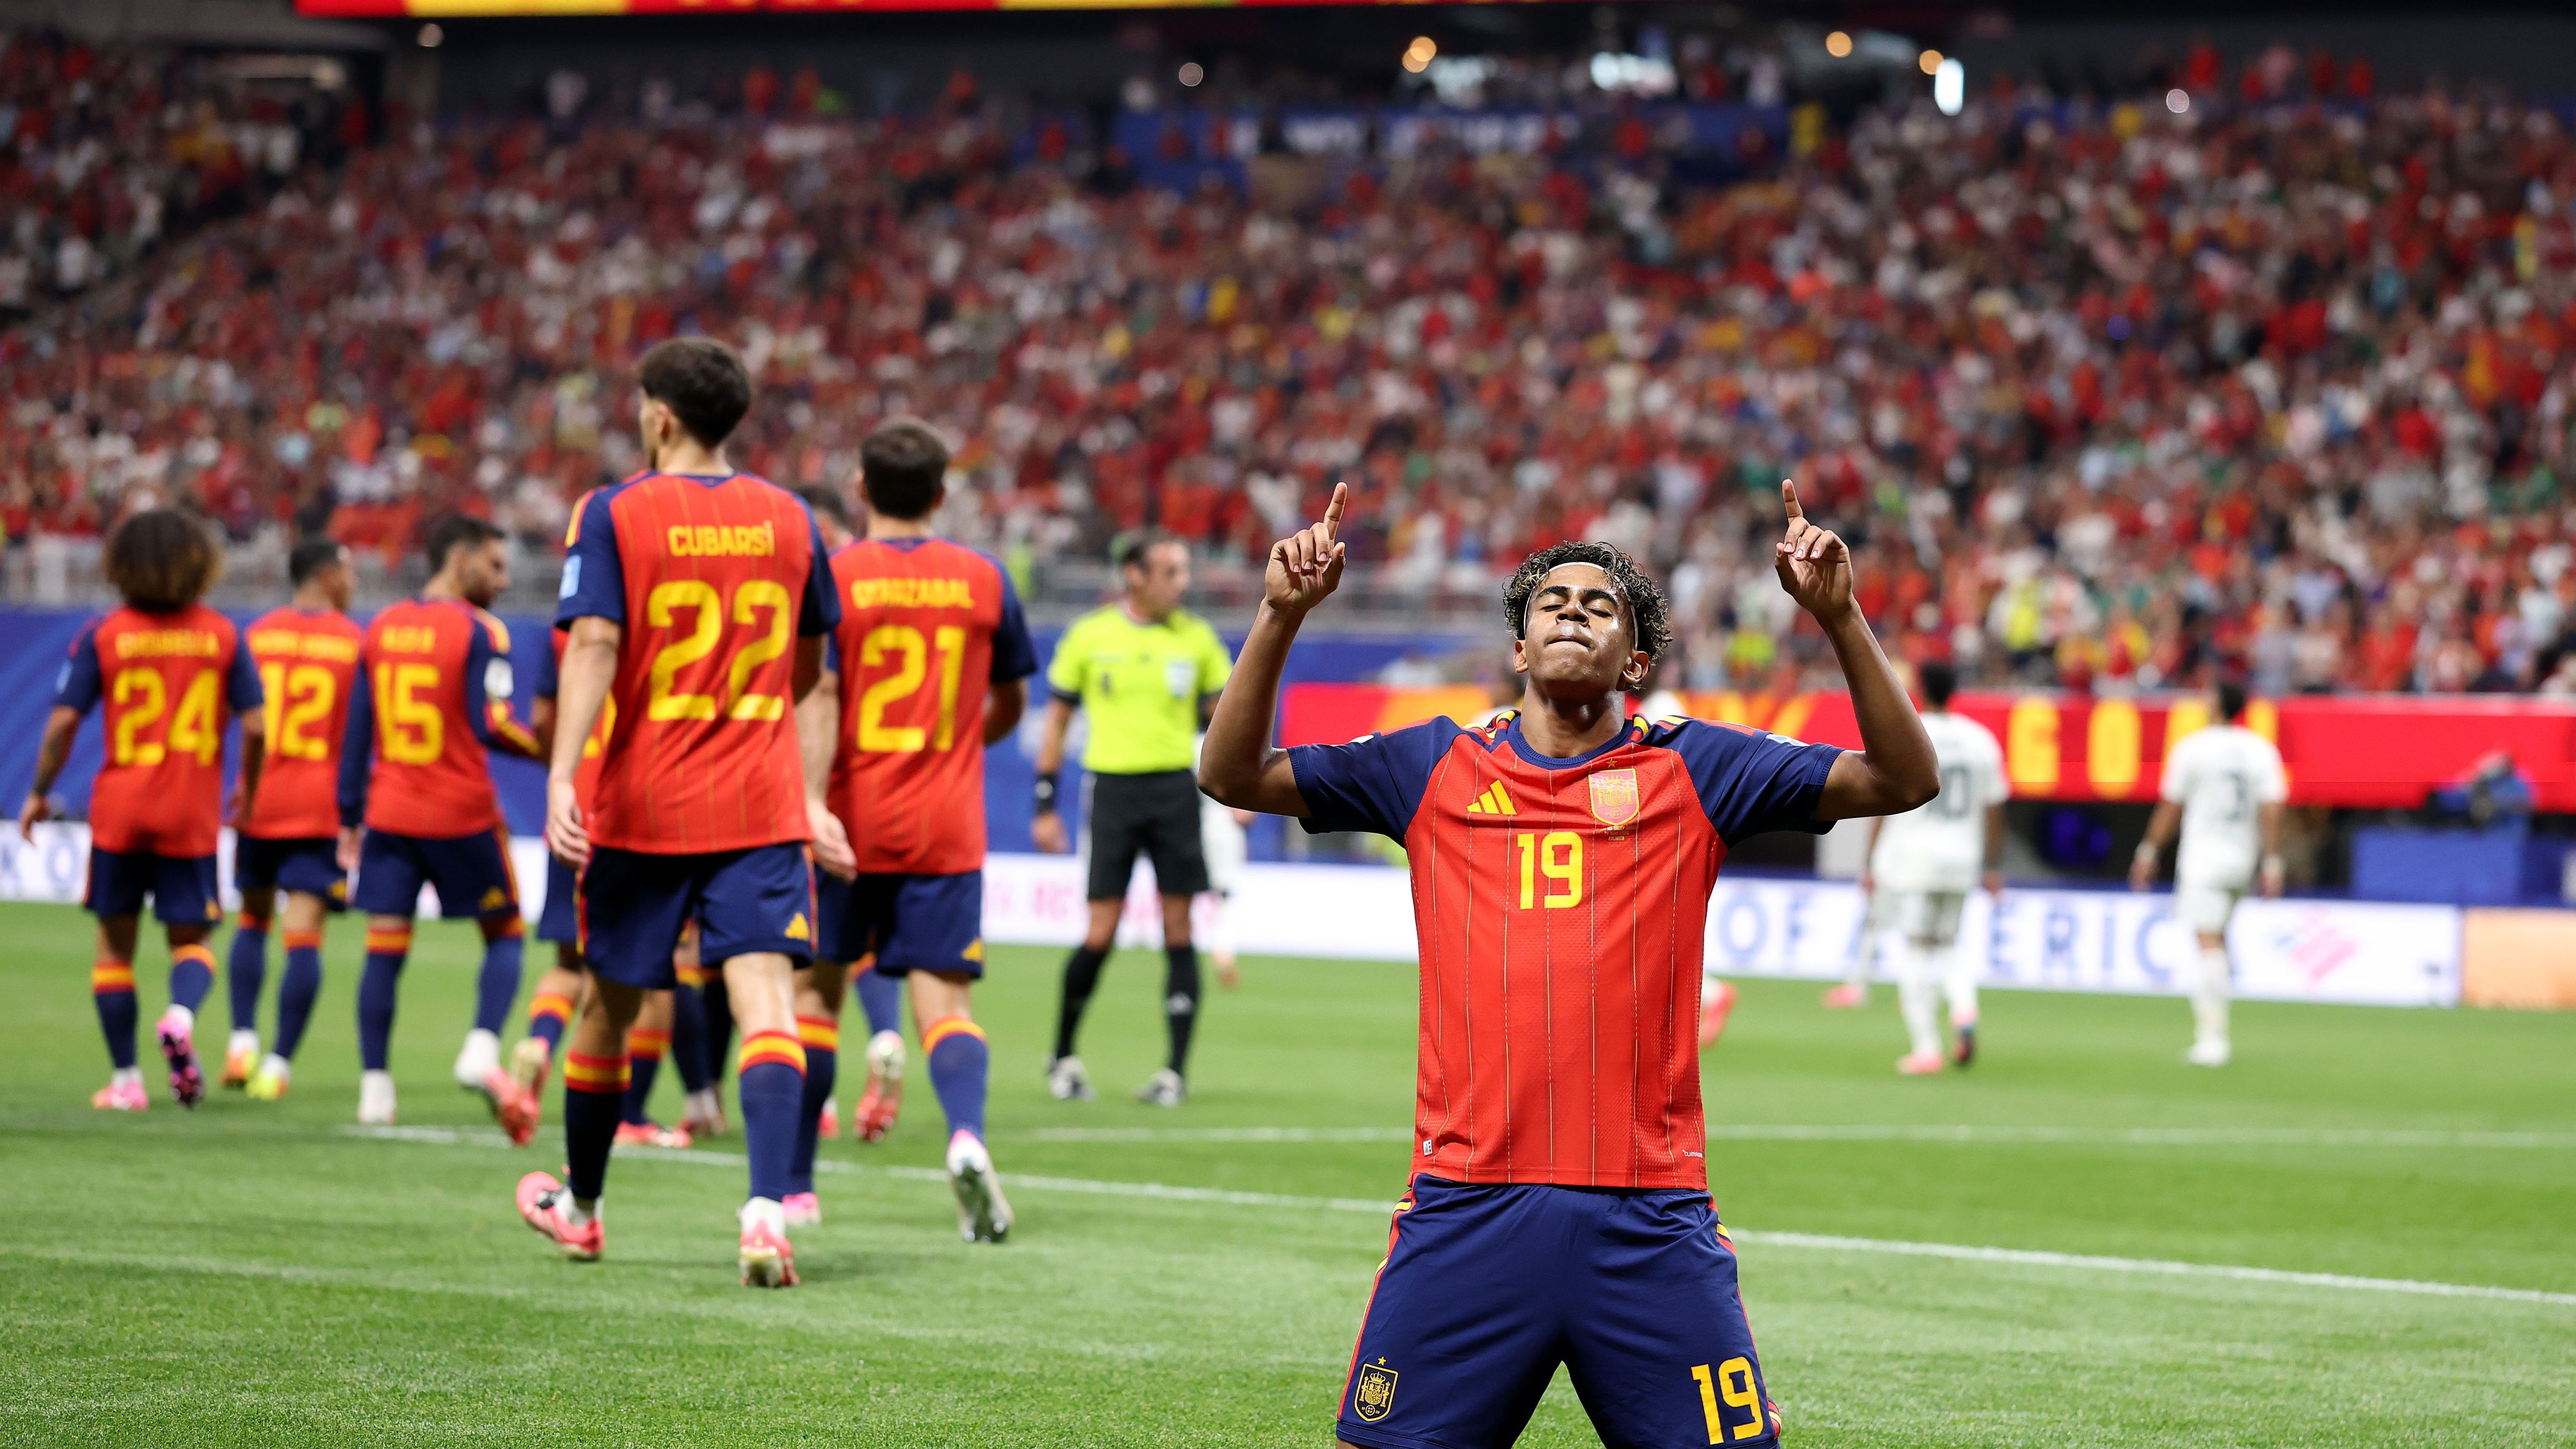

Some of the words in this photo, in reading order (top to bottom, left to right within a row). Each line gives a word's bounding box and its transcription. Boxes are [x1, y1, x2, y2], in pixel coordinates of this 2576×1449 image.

[648, 580, 791, 722] 22
[857, 625, 965, 753] 21
[114, 669, 218, 767] 24
[262, 662, 335, 760] 12
[376, 662, 442, 763] 15
[1517, 831, 1583, 910] 19
[1691, 1357, 1764, 1445] 19
